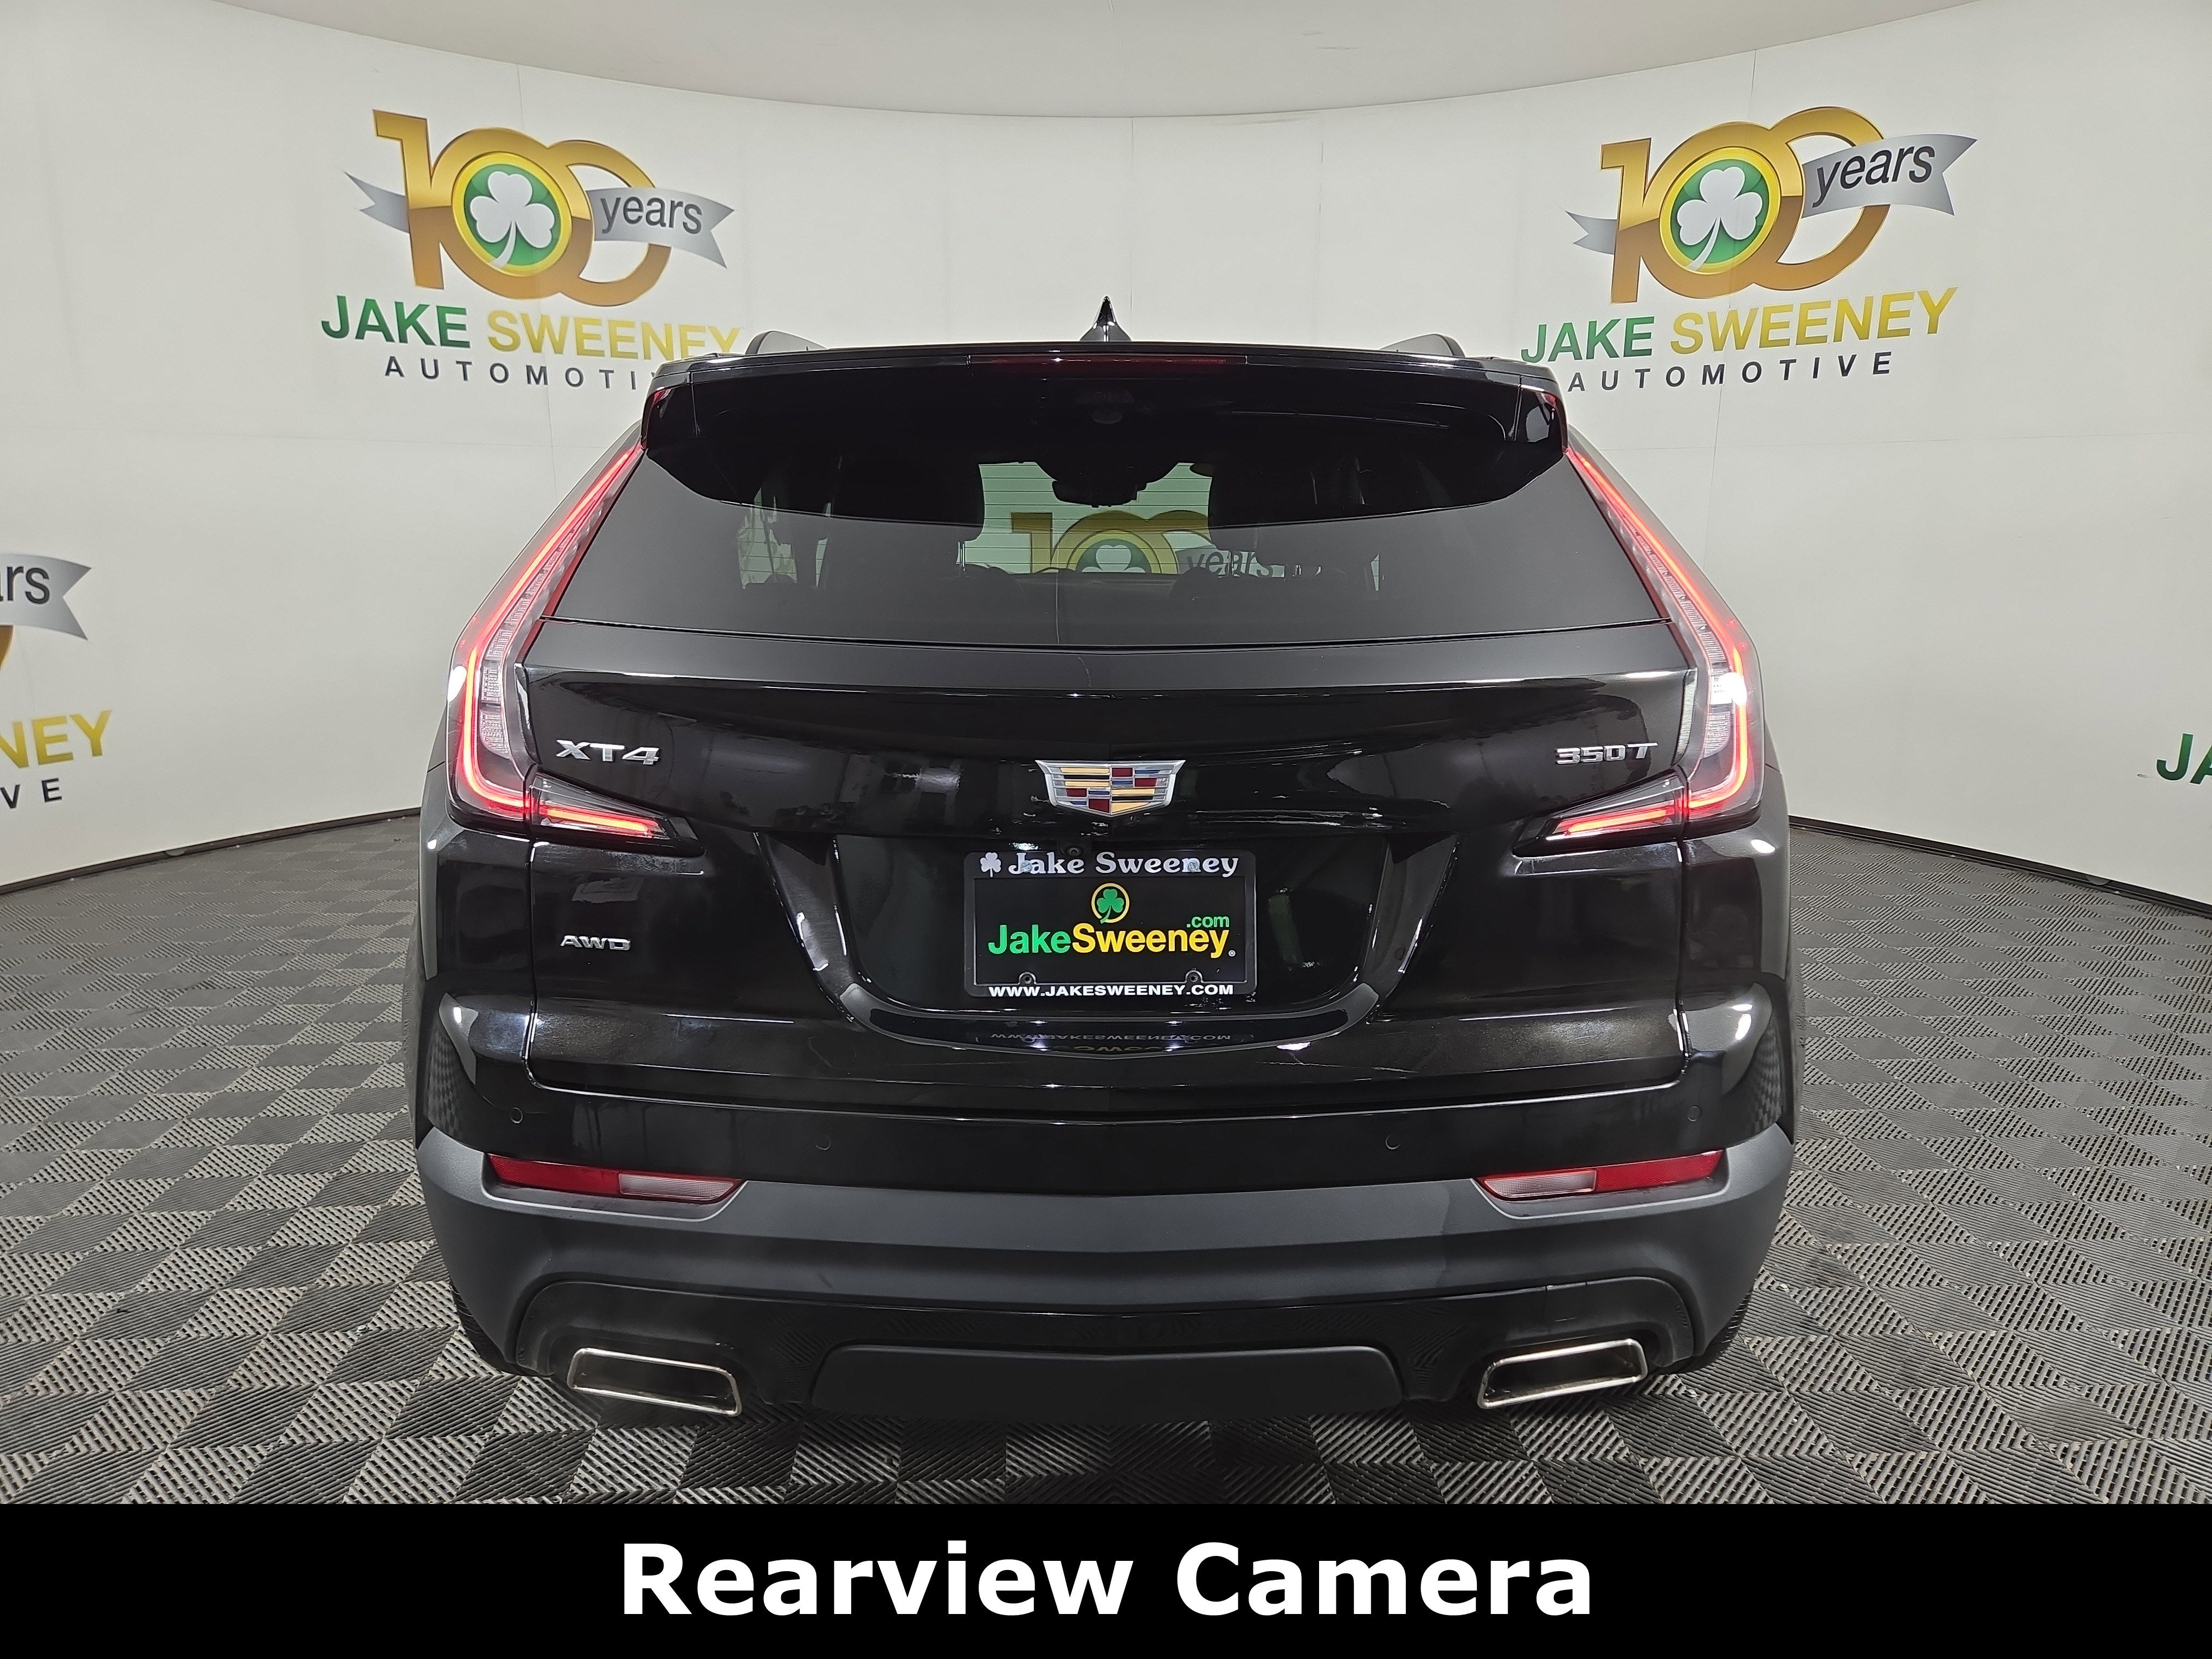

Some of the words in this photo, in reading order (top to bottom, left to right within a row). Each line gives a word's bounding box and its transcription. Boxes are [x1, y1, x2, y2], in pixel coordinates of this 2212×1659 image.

[1811, 144, 1936, 208] years
[372, 109, 672, 307] 100
[599, 196, 703, 235] years
[1600, 106, 1892, 304] 100
[321, 294, 471, 349] JAKE
[487, 310, 741, 361] SWEENEY
[1521, 316, 1655, 363] JAKE
[1670, 286, 1959, 356] SWEENEY
[385, 355, 655, 390] AUTOMOTI
[1567, 351, 1894, 393] AUTOMOTIVE
[0, 566, 50, 605] rs
[556, 739, 661, 766] XT4
[1555, 742, 1659, 766] 350T
[1008, 852, 1085, 874] Jake
[1095, 851, 1239, 877] Sweeney
[1186, 915, 1230, 928] .com
[560, 935, 631, 951] AWD
[988, 985, 1233, 997] WWW.JAKESWEENEY.COM
